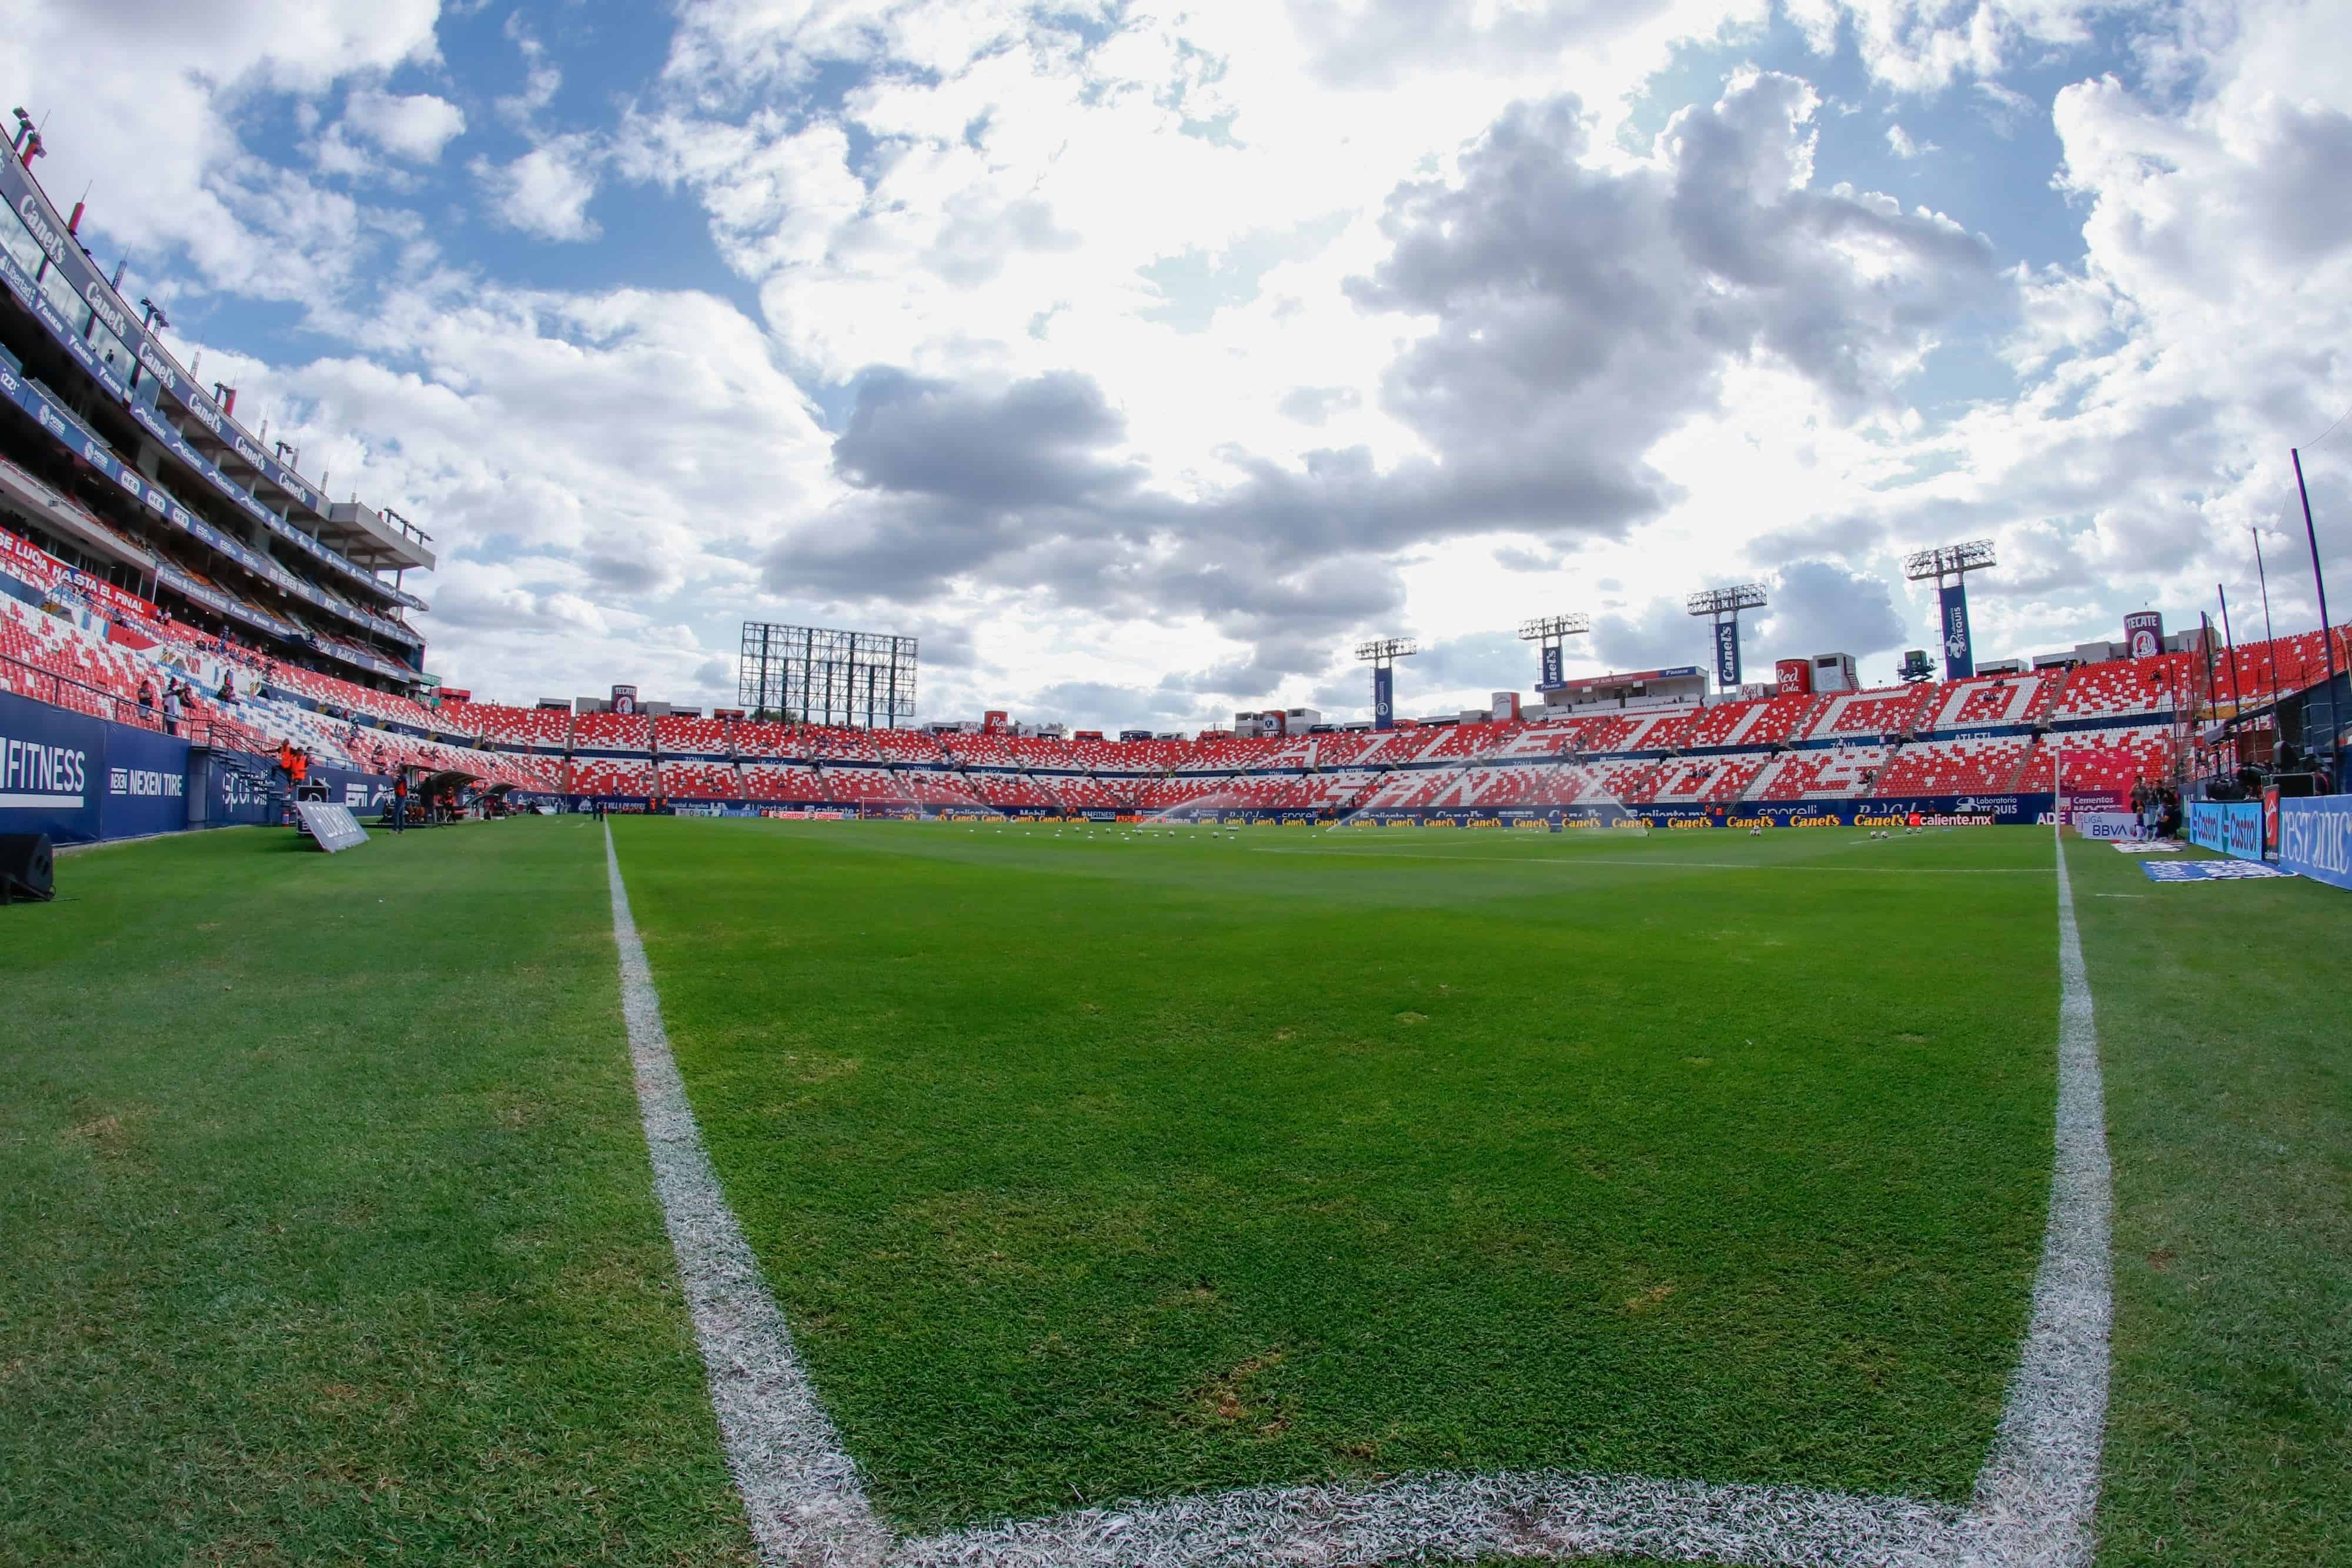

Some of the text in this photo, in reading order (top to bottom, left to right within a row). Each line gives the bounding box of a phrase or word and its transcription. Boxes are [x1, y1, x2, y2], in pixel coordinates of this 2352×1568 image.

[20, 195, 65, 263] Canel's
[87, 282, 127, 337] Canel's
[139, 342, 176, 389] Canel's
[189, 393, 222, 433] Canel's
[235, 436, 265, 470] Canel's
[279, 473, 308, 502] Canel's
[15, 541, 48, 573] LUCHA
[52, 565, 98, 593] HASTA
[100, 584, 112, 599] EL
[115, 591, 145, 614] FINAL
[1954, 606, 1964, 637] TEQUIS
[2126, 615, 2157, 630] TECATE
[1722, 626, 1735, 682] Canel's
[1777, 667, 1800, 683] Red
[615, 687, 636, 696] TECATE
[1782, 684, 1799, 693] Cola
[130, 770, 182, 796] NEXEN TIRE
[1282, 818, 1307, 826] Canel's
[1387, 818, 1416, 827] Canel's
[1424, 818, 1456, 827] Canel's
[1466, 818, 1502, 828] Canel's
[1513, 818, 1549, 828] Canel's
[1562, 817, 1602, 828] Canel's
[1612, 817, 1655, 828] Canel's
[1668, 817, 1713, 828] Canel's
[1727, 816, 1775, 827] Canel's
[1790, 814, 1840, 827] Canel's
[1853, 813, 1905, 826] Canel's
[1921, 813, 1992, 825] caliente.mx
[2083, 815, 2103, 824] LIGA
[2092, 824, 2127, 836] BBVA
[2197, 810, 2219, 842] Castrol
[2230, 811, 2257, 852] Castrol
